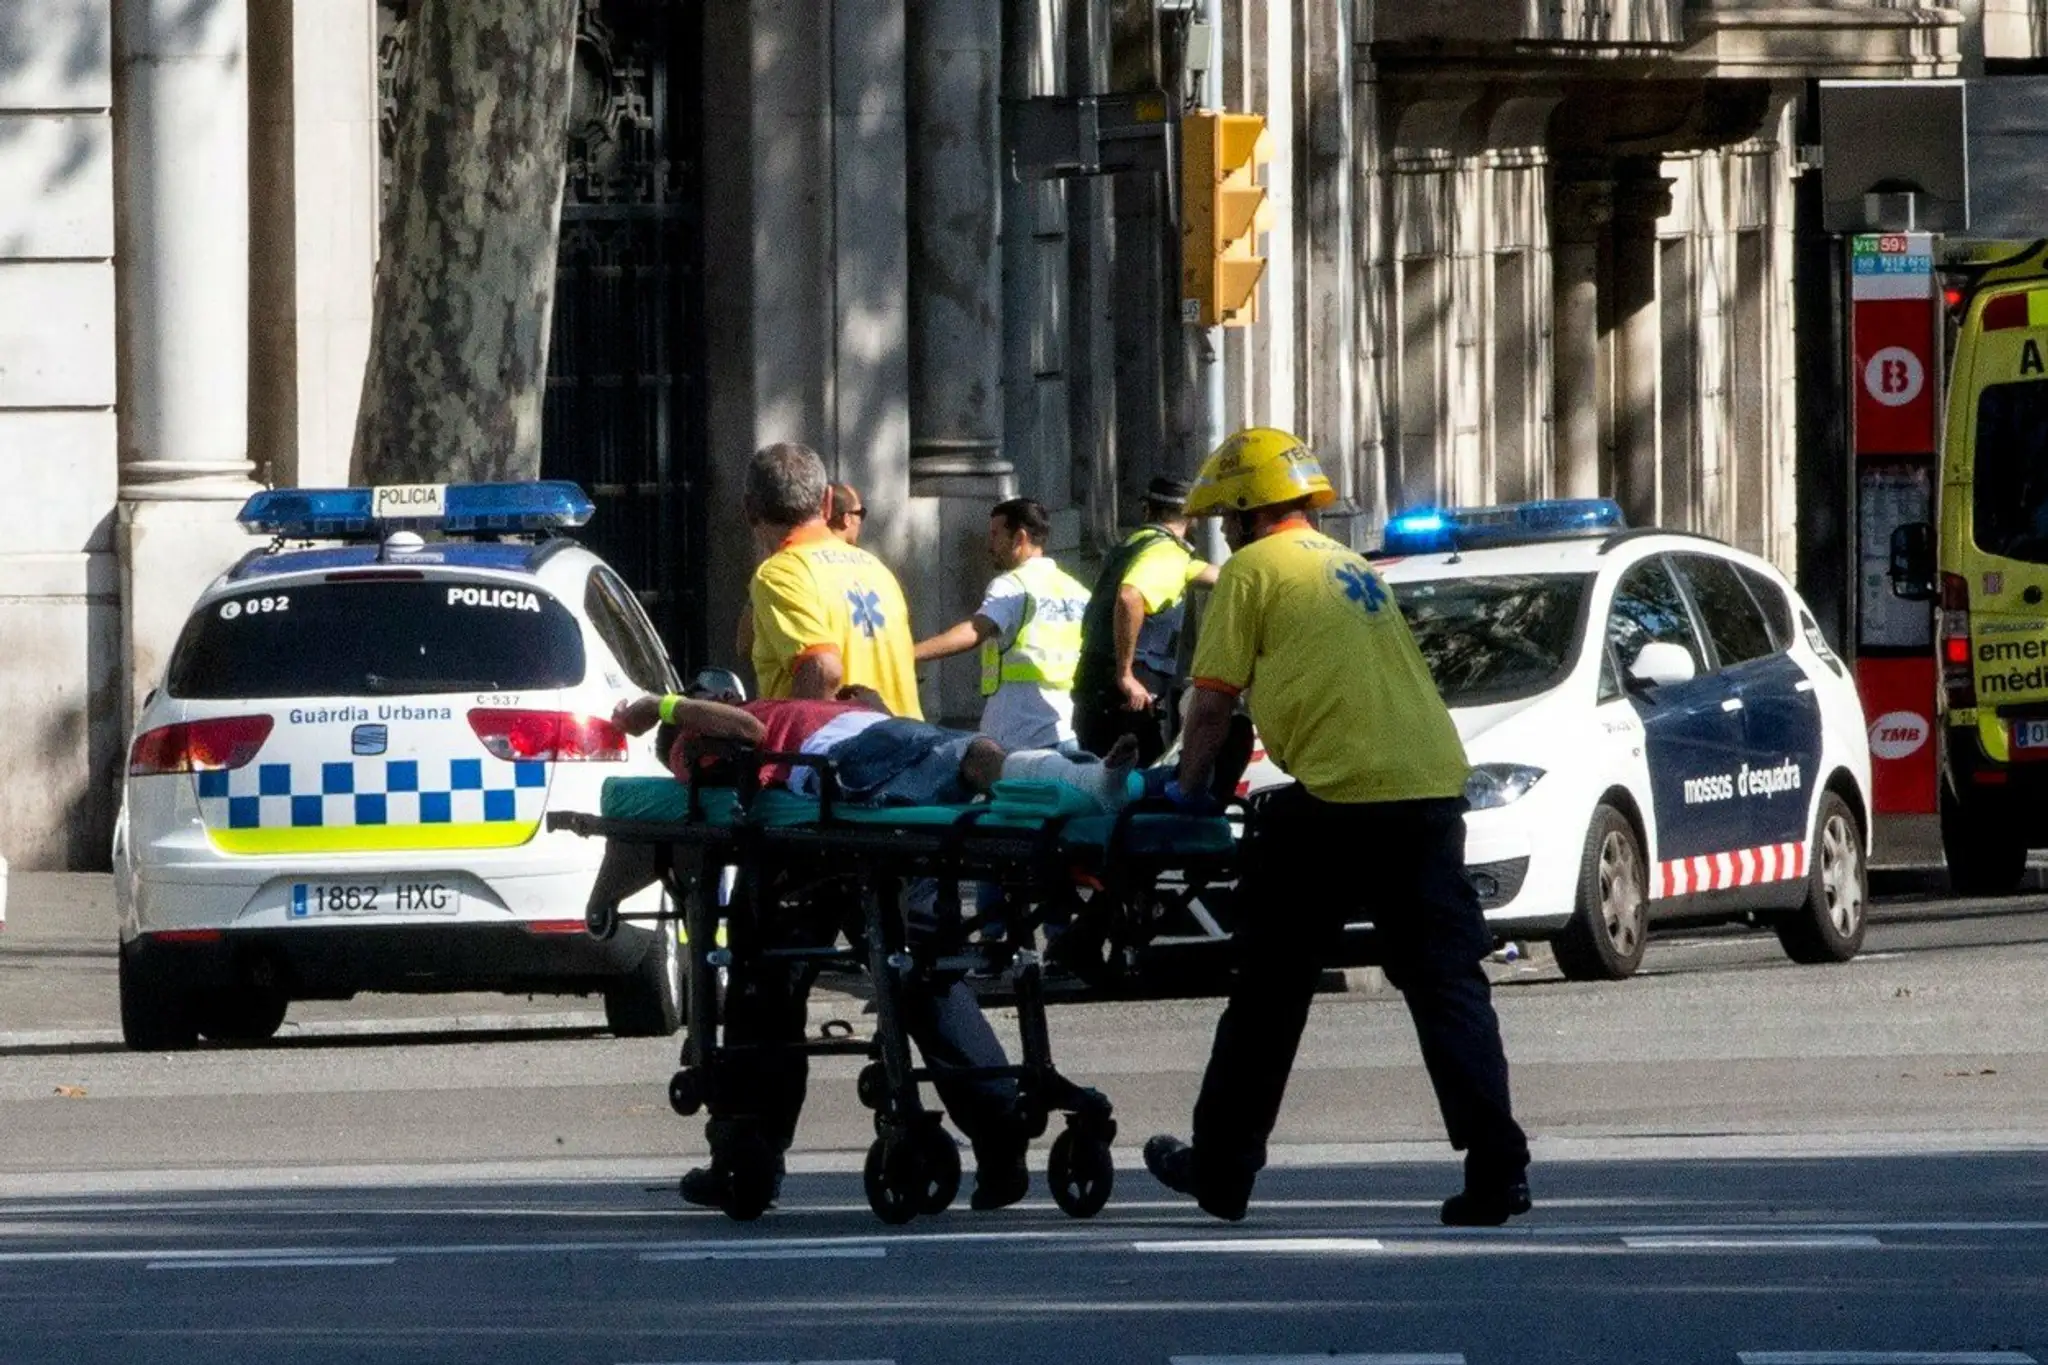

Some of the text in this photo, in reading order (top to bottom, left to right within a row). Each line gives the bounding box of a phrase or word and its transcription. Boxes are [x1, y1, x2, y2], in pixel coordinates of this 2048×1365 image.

[1881, 360, 1908, 393] B
[379, 488, 437, 505] POLICIA
[245, 595, 289, 614] 092
[447, 587, 540, 612] POLICIA
[289, 705, 452, 724] Guàrdia Urbana
[1881, 728, 1920, 742] TMB
[1684, 773, 1733, 804] mossos
[315, 884, 447, 911] 1862 HXG
